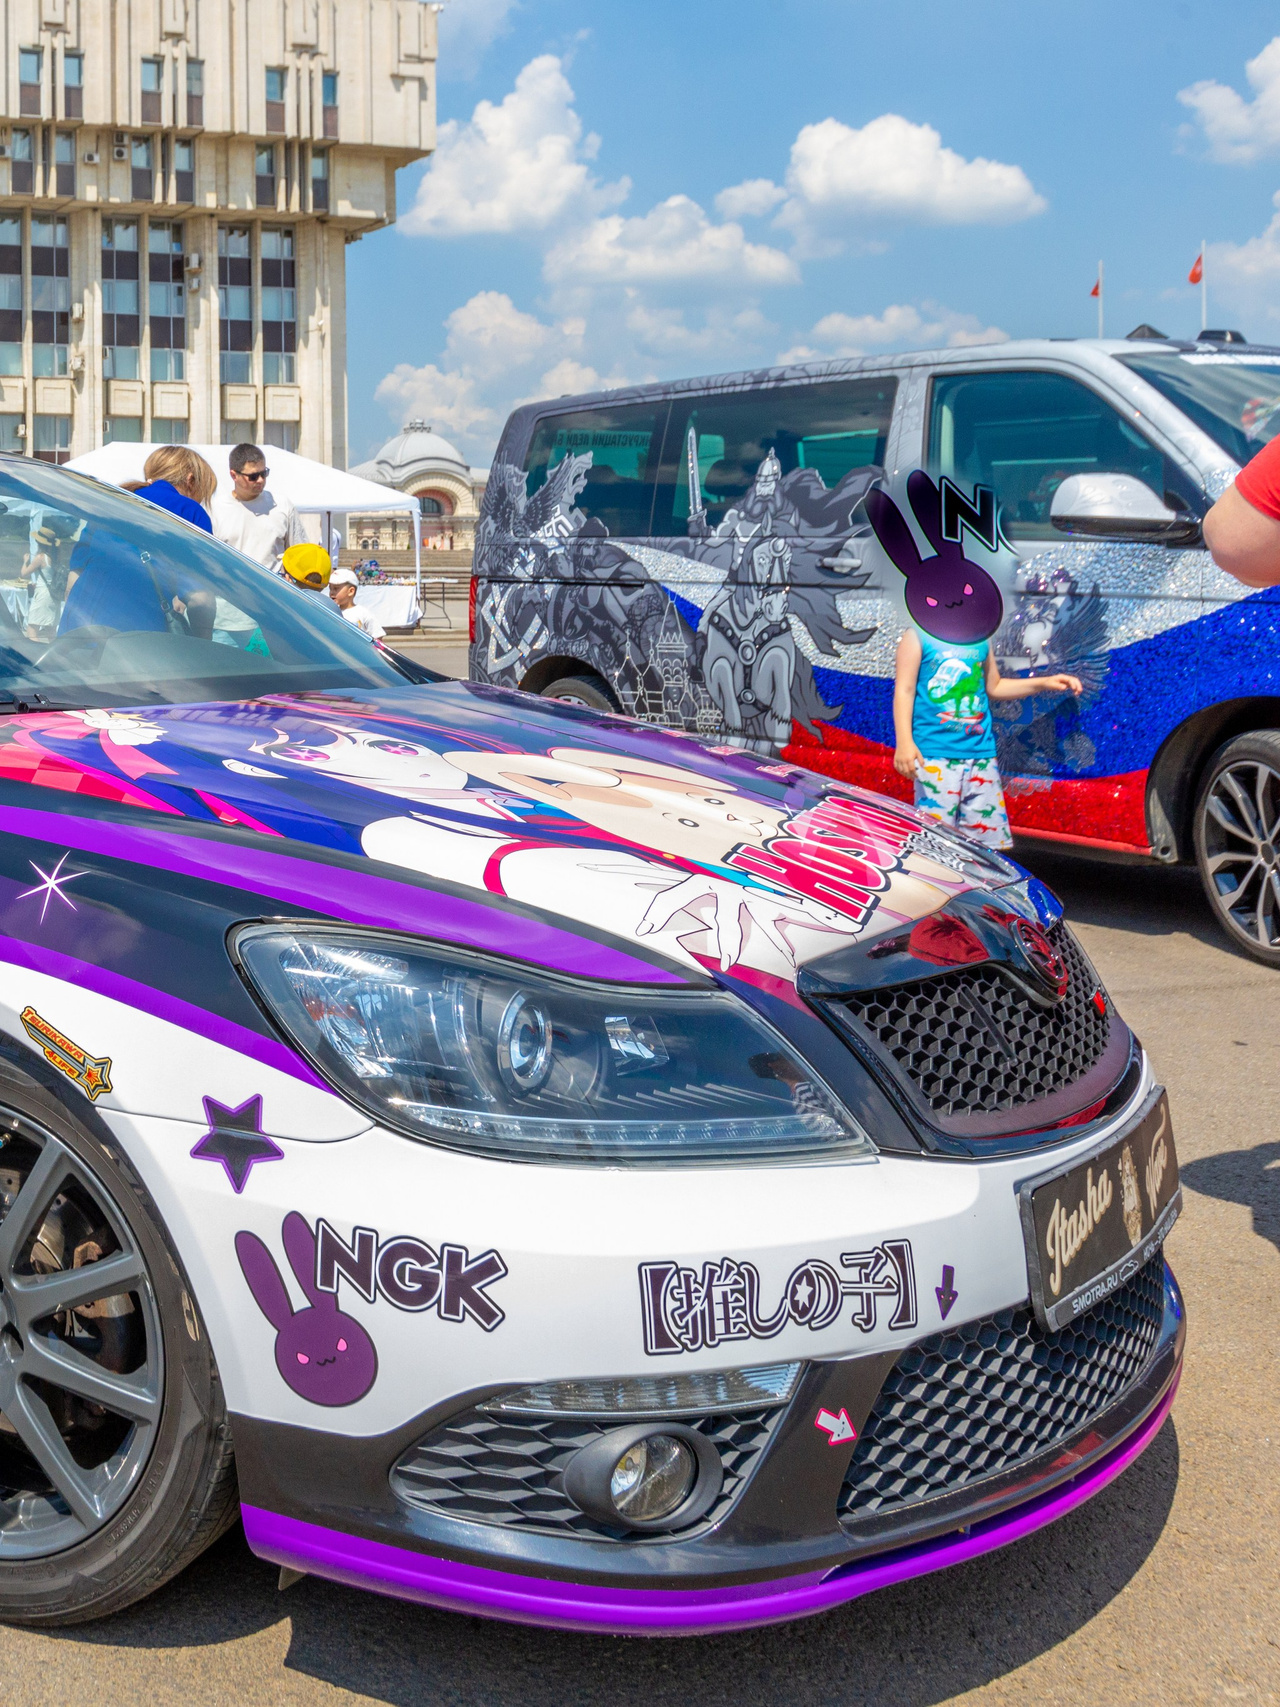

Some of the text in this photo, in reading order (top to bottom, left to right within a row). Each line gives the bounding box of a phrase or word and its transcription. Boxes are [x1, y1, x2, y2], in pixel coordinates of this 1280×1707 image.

[24, 1008, 84, 1060] TSURIKAWA
[45, 1050, 77, 1077] 4LIFE
[1046, 1166, 1113, 1296] Itasha
[314, 1218, 508, 1333] NGK
[1071, 1272, 1118, 1314] SMOTRA.RU
